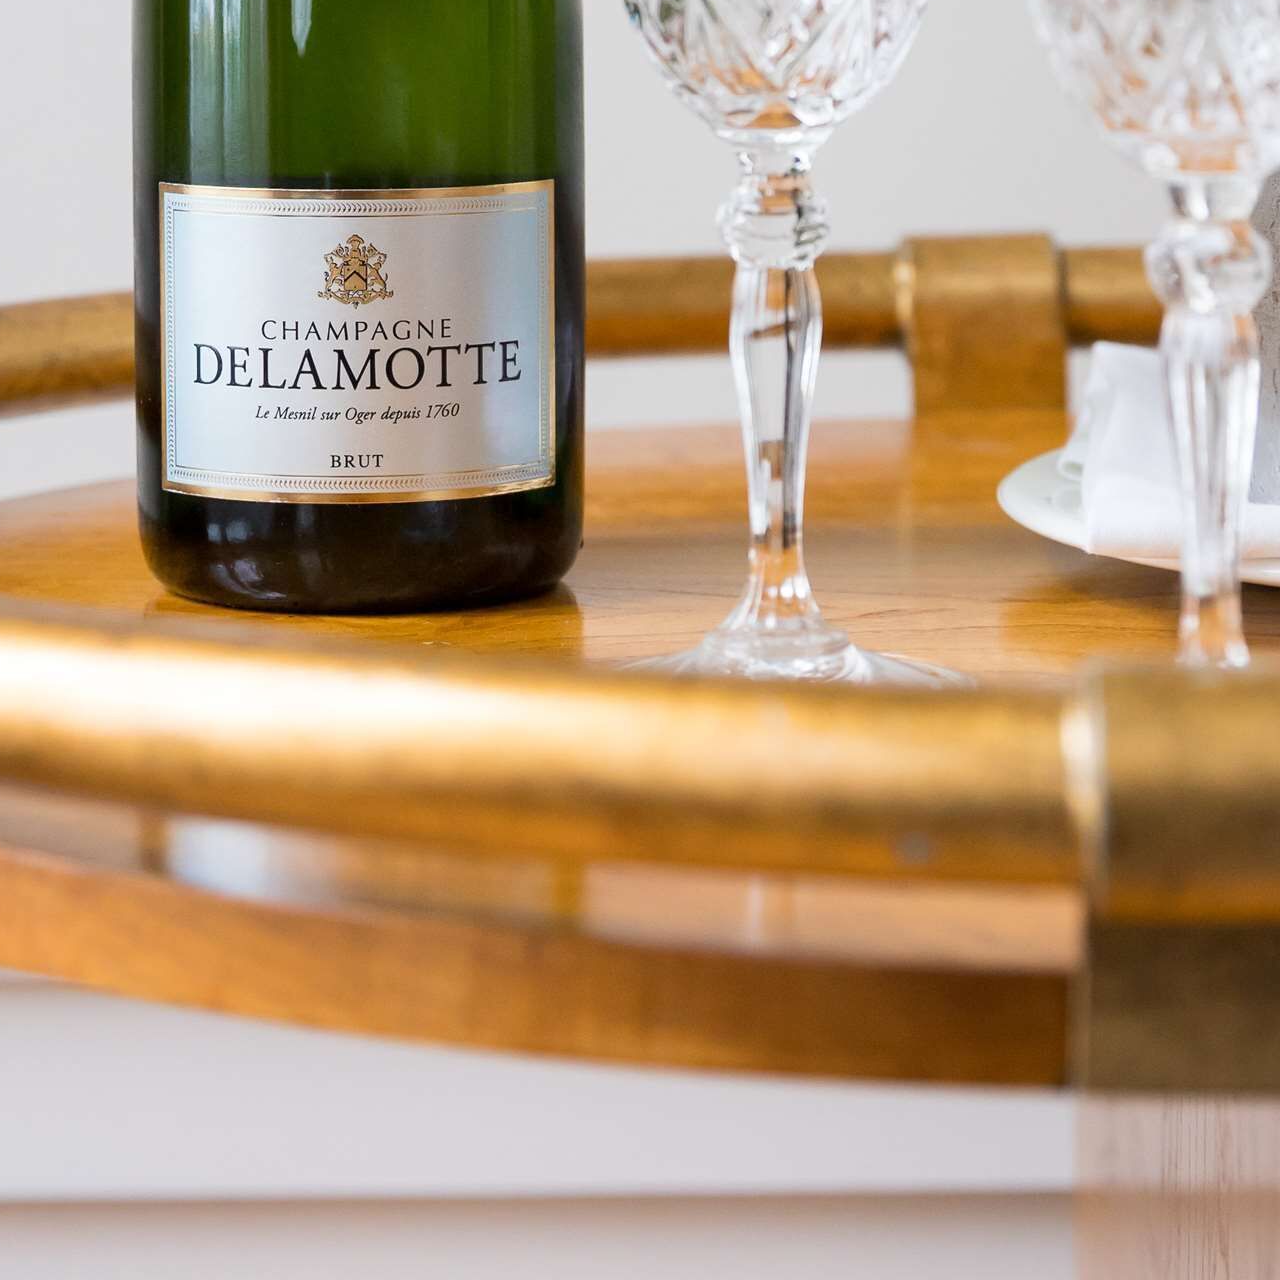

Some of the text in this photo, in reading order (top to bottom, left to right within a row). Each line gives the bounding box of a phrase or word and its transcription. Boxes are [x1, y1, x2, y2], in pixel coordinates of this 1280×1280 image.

[261, 318, 452, 341] CHAMPAGNE
[193, 340, 523, 391] DELAMOTTE
[255, 403, 460, 425] Le Mesnil sur Oger depuis 1760
[330, 454, 385, 469] BRUT
